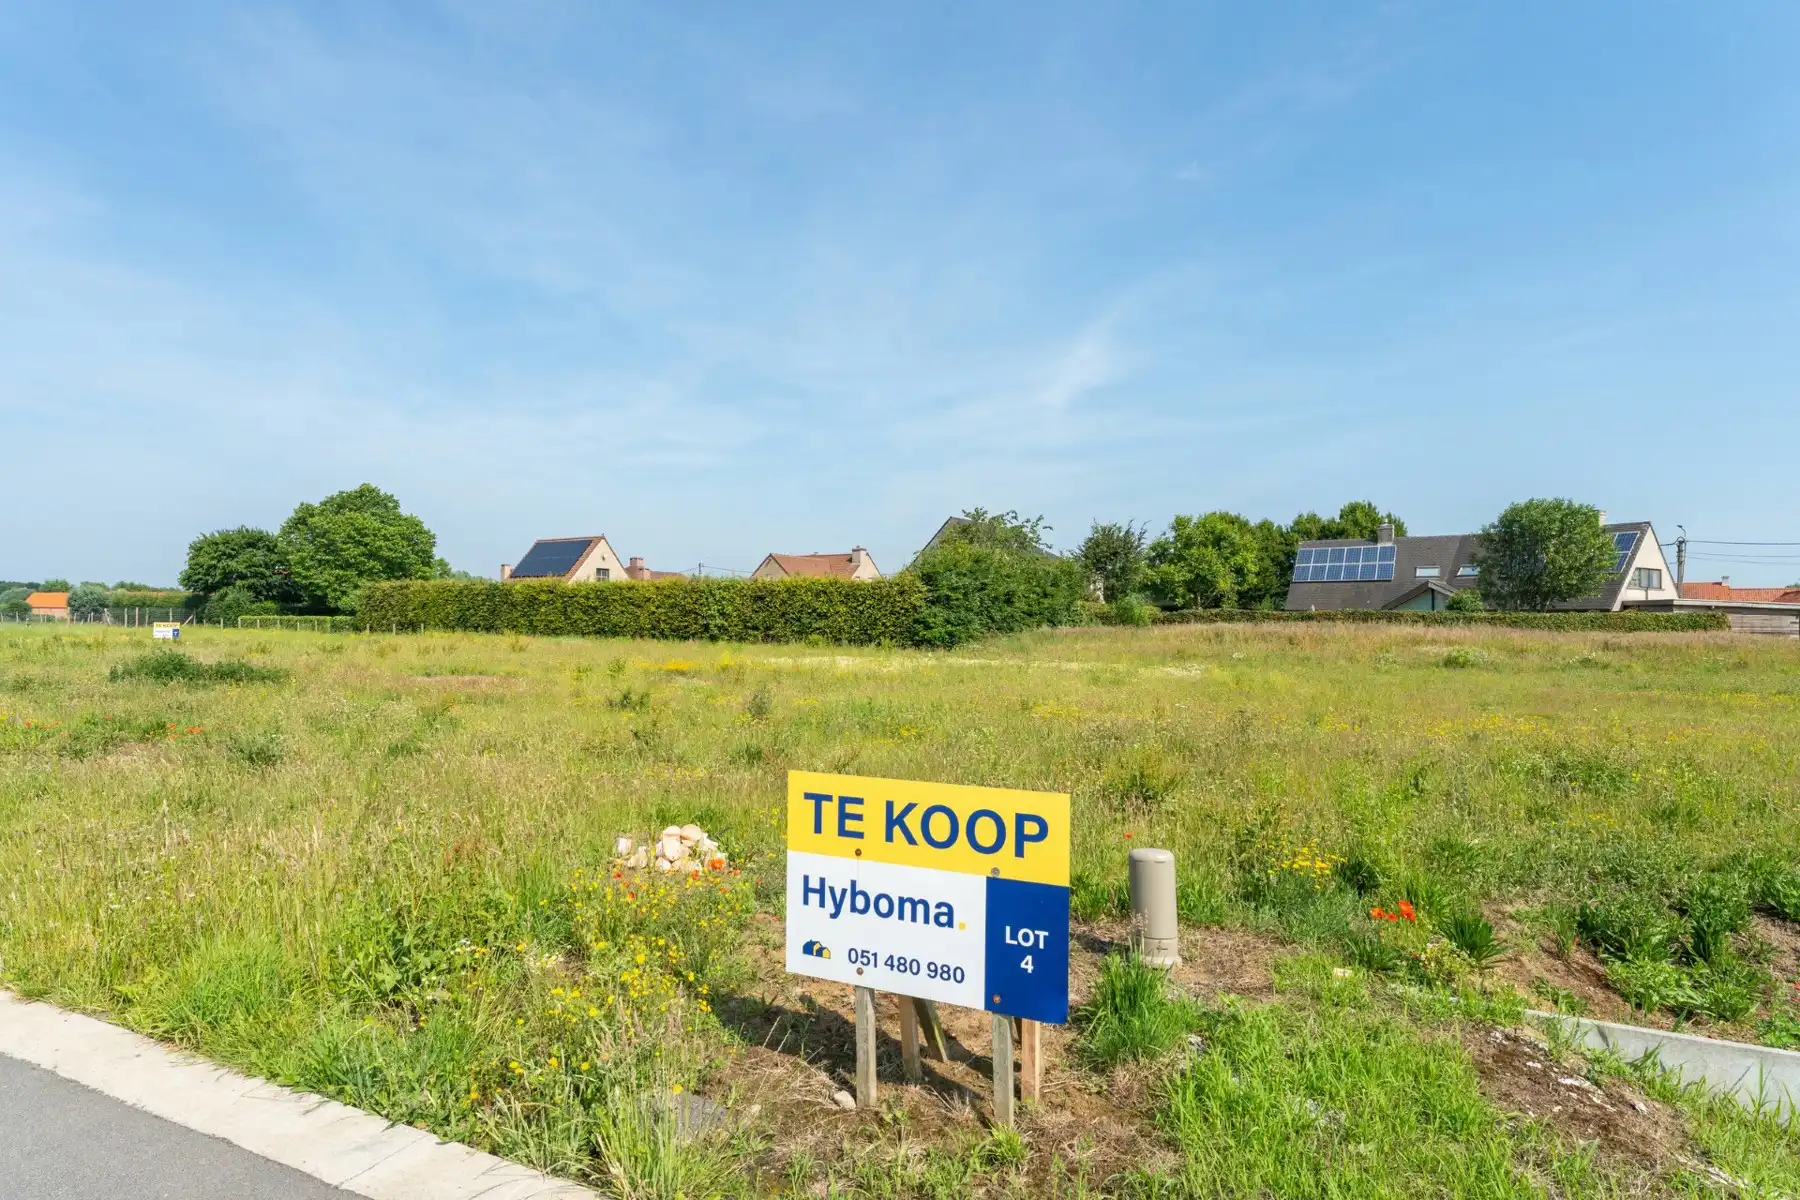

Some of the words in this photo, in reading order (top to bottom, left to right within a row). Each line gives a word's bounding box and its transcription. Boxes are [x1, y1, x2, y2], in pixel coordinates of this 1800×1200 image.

[803, 792, 865, 840] TE
[884, 800, 1049, 859] KOOP
[1005, 926, 1049, 949] LOT
[848, 948, 879, 968] 051
[884, 954, 921, 976] 480
[926, 961, 965, 984] 980
[1020, 955, 1034, 973] 4
